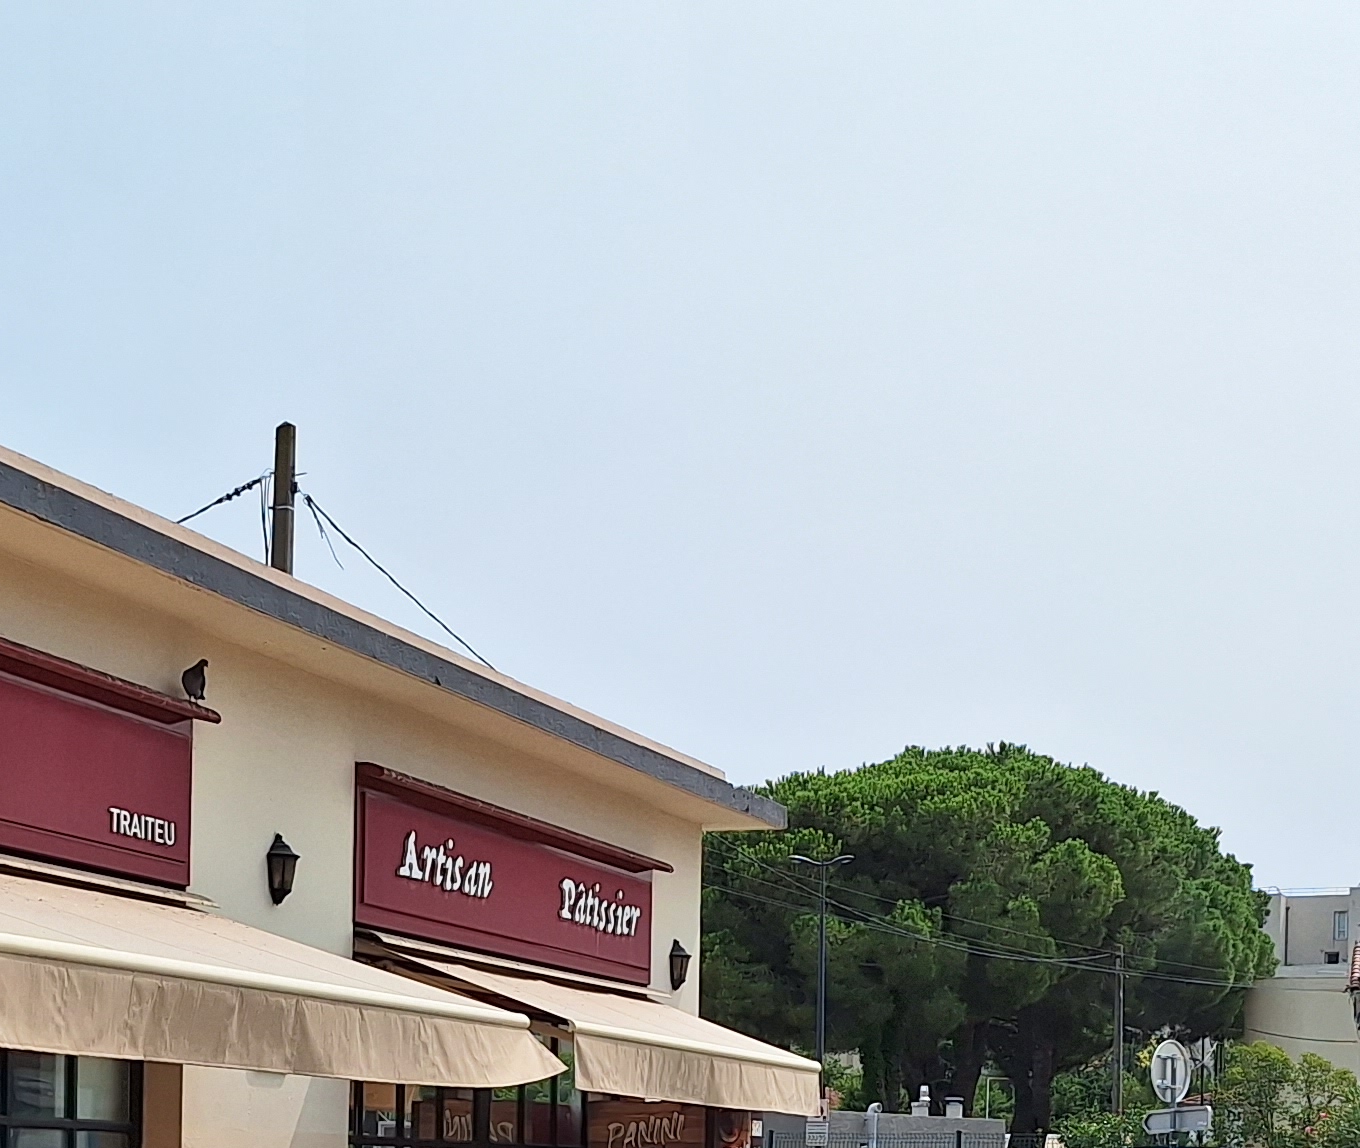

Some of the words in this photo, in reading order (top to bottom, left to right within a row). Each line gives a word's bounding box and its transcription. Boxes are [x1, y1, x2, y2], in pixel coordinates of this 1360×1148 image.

[109, 806, 177, 848] TRAITEU
[396, 830, 494, 900] Artisan
[558, 877, 641, 937] Pâtissier
